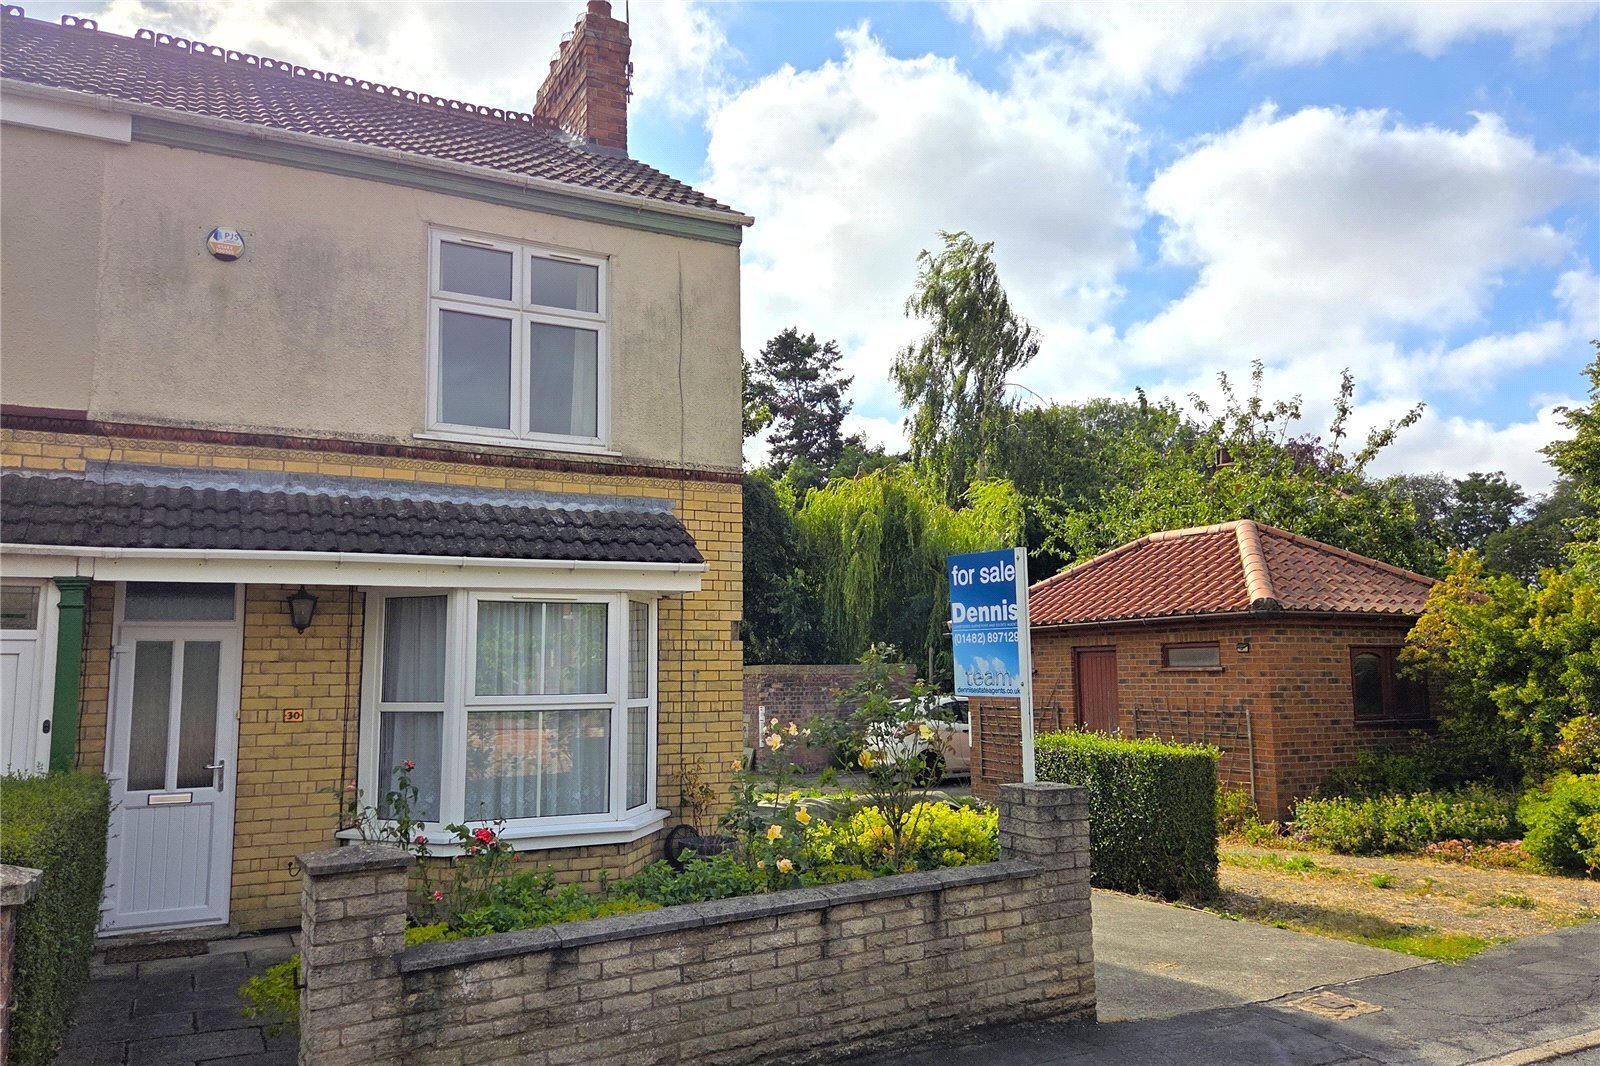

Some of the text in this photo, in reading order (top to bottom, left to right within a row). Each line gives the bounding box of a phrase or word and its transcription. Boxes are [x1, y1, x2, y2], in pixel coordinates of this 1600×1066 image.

[224, 232, 239, 241] PJS
[951, 560, 1015, 586] for sale
[951, 599, 1018, 623] Dennis
[954, 631, 1018, 646] (01482) 897129
[965, 669, 1012, 687] team
[286, 711, 300, 720] 30
